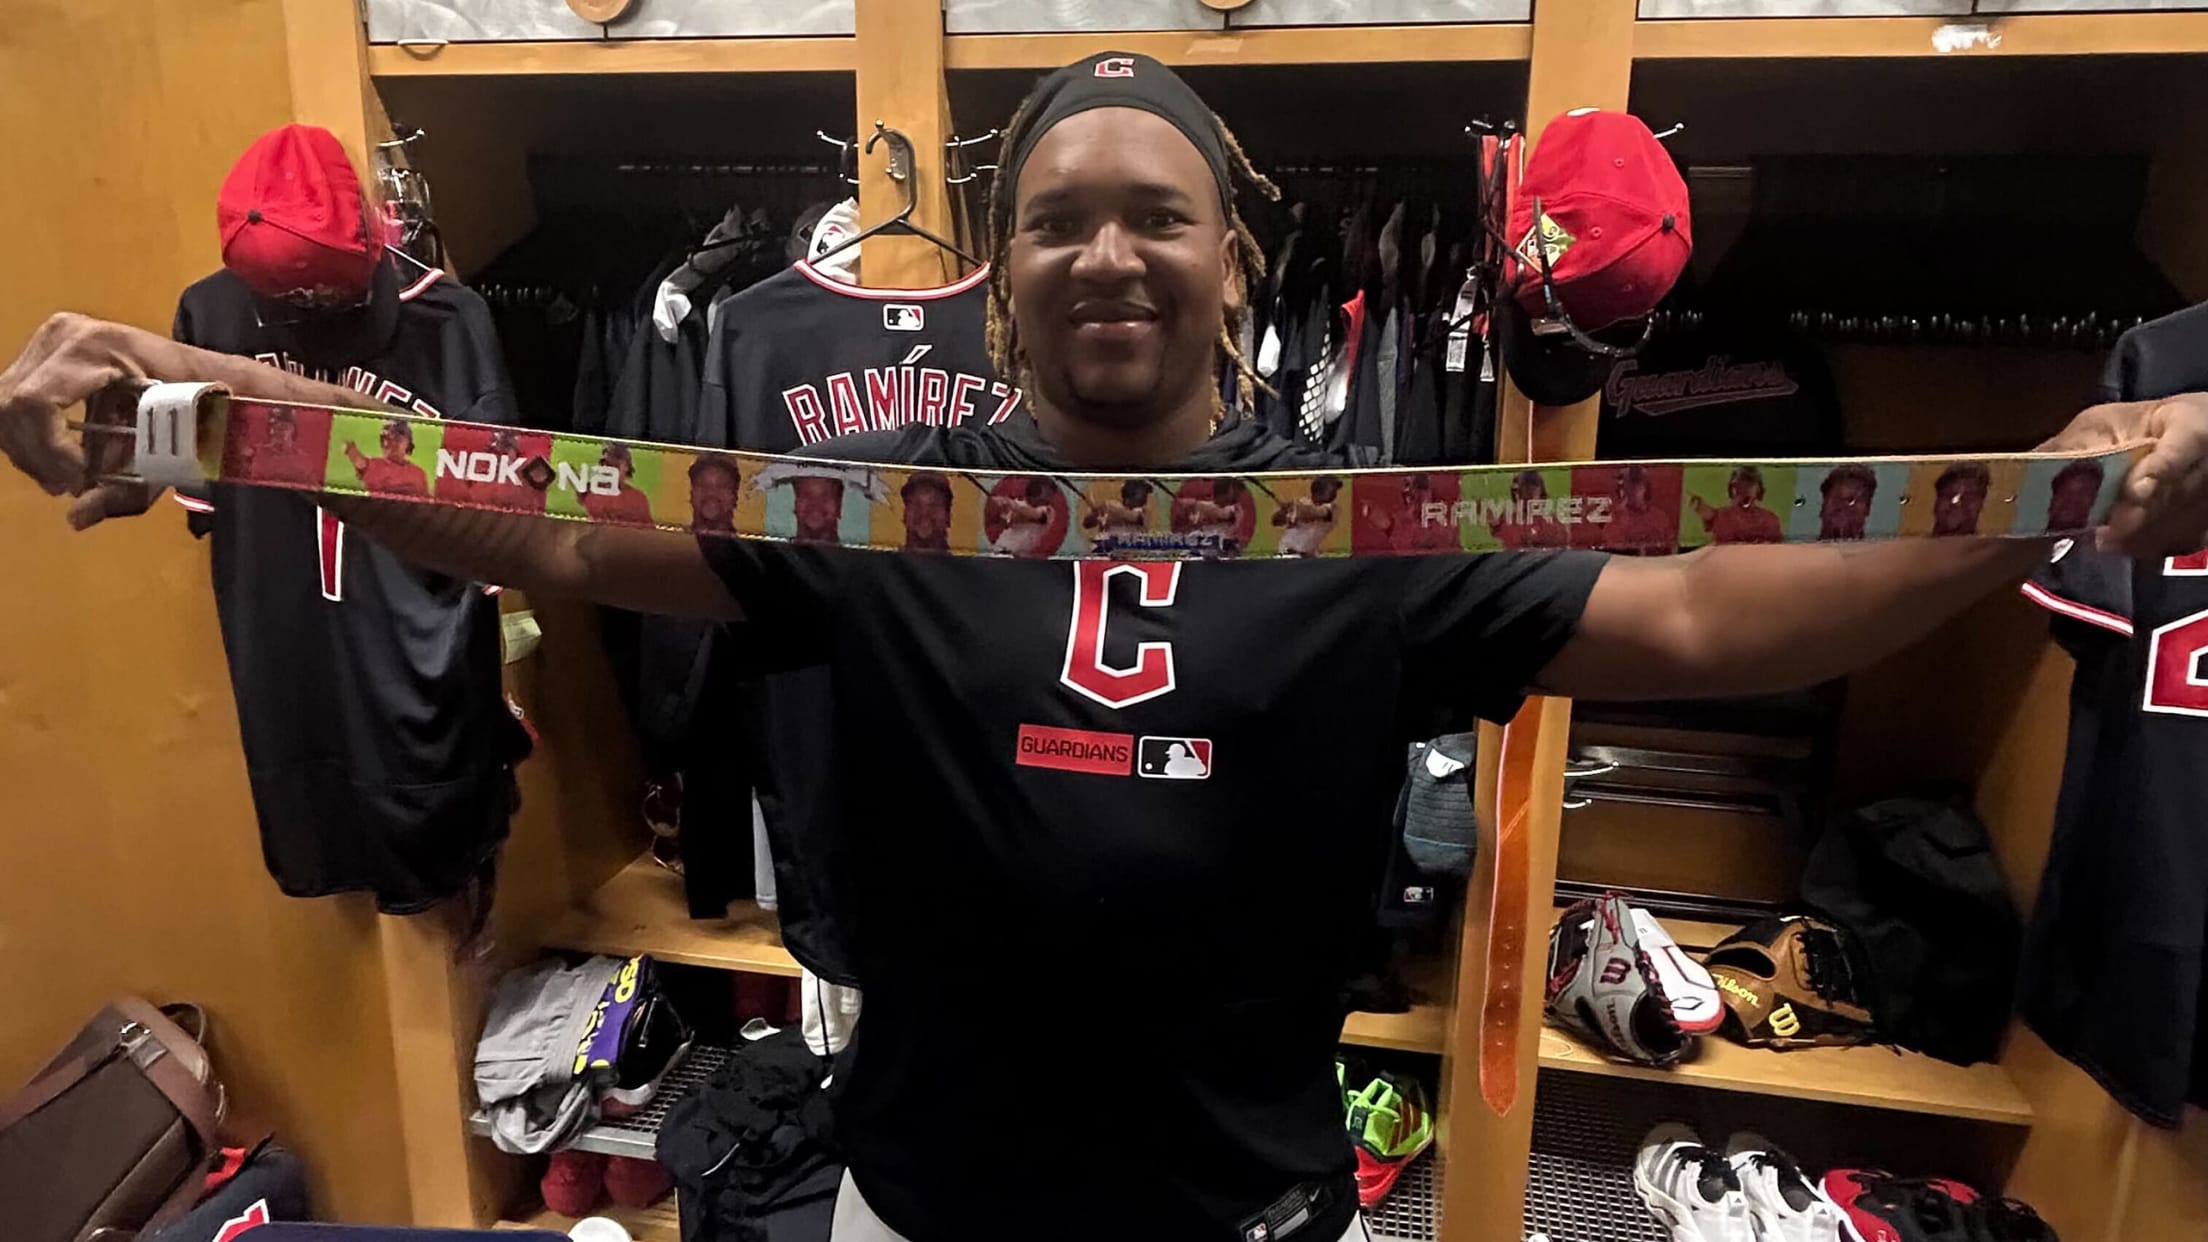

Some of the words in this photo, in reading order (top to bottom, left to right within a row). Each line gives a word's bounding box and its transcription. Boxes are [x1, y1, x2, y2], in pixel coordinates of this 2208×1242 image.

[1094, 58, 1135, 77] C
[1421, 497, 1613, 528] RAMIREZ
[1060, 560, 1183, 709] C
[1021, 736, 1129, 763] GUARDIANS
